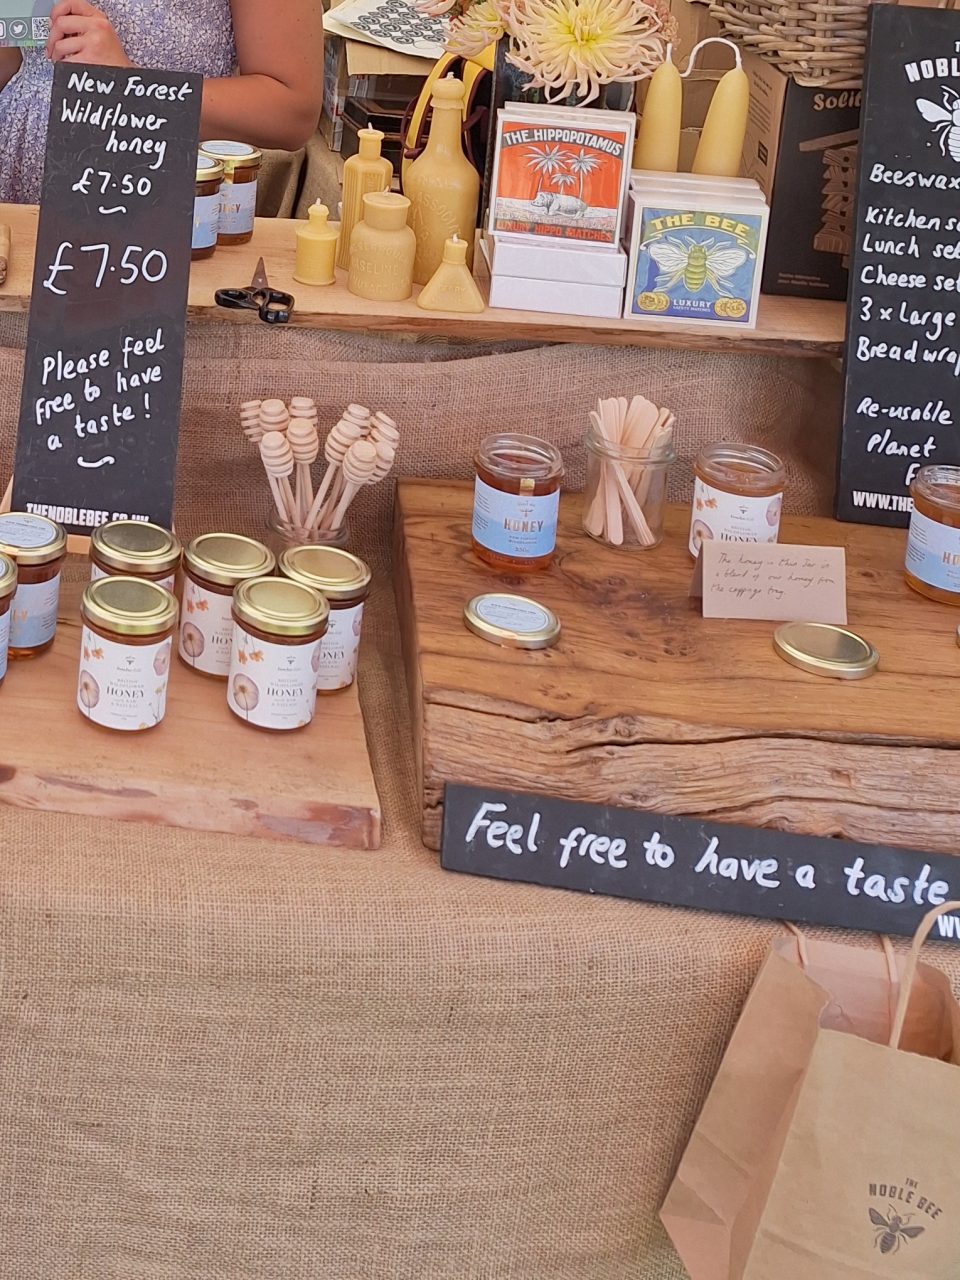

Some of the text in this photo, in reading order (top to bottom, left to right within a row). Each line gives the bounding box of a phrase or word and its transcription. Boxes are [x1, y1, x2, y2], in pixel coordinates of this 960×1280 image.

[904, 57, 960, 83] NOBL
[67, 71, 193, 102] New Forest
[60, 98, 168, 131] Wildflower
[105, 130, 167, 170] honey
[503, 128, 624, 157] THE HIPPOPOTAMUS
[71, 167, 152, 196] £7.50
[869, 163, 960, 191] Beeswax
[496, 219, 612, 241] LUXURY HIPPO MATCHES
[651, 214, 750, 238] THE BEE
[865, 205, 941, 232] Kitchen
[862, 232, 920, 258] Lunch
[42, 241, 169, 296] £7.50
[860, 265, 927, 288] Cheese
[673, 299, 712, 308] LUXURY
[859, 296, 873, 321] 3
[899, 301, 957, 341] Large
[42, 327, 165, 386] Please feel
[856, 336, 918, 363] Bread
[35, 365, 162, 425] free to have
[856, 396, 954, 425] Re-usable
[47, 434, 63, 451] a
[503, 517, 544, 533] HONEY
[106, 685, 144, 699] HONEY
[266, 687, 304, 697] HONEY
[465, 802, 949, 906] Feel free to have a taste
[905, 1177, 919, 1189] THE
[868, 1183, 943, 1220] NOBLE BEE
